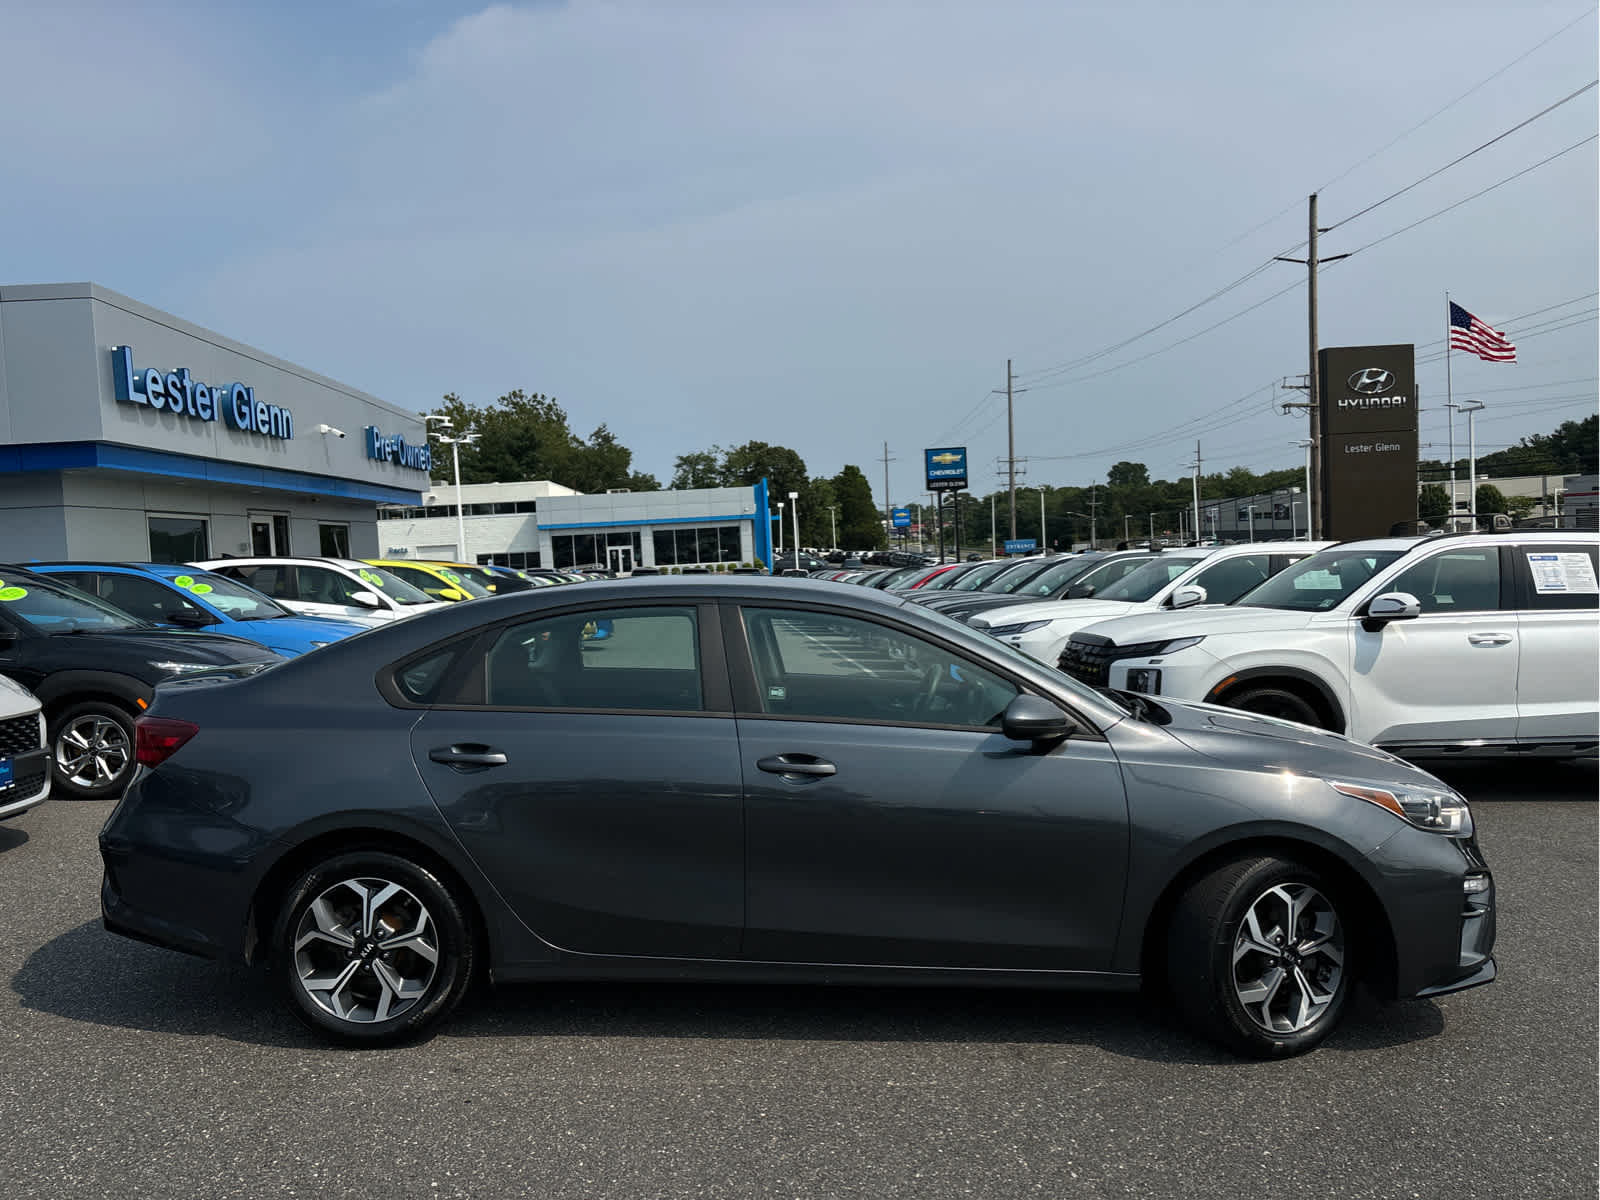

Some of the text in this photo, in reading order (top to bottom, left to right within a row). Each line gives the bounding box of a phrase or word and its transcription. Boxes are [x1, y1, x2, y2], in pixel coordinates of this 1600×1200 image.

[113, 346, 294, 440] Lester Glenn
[1338, 396, 1407, 409] HYUNDAI
[367, 426, 431, 471] Pre-Owned
[1345, 442, 1400, 453] Lester Glenn
[361, 943, 374, 957] KIA
